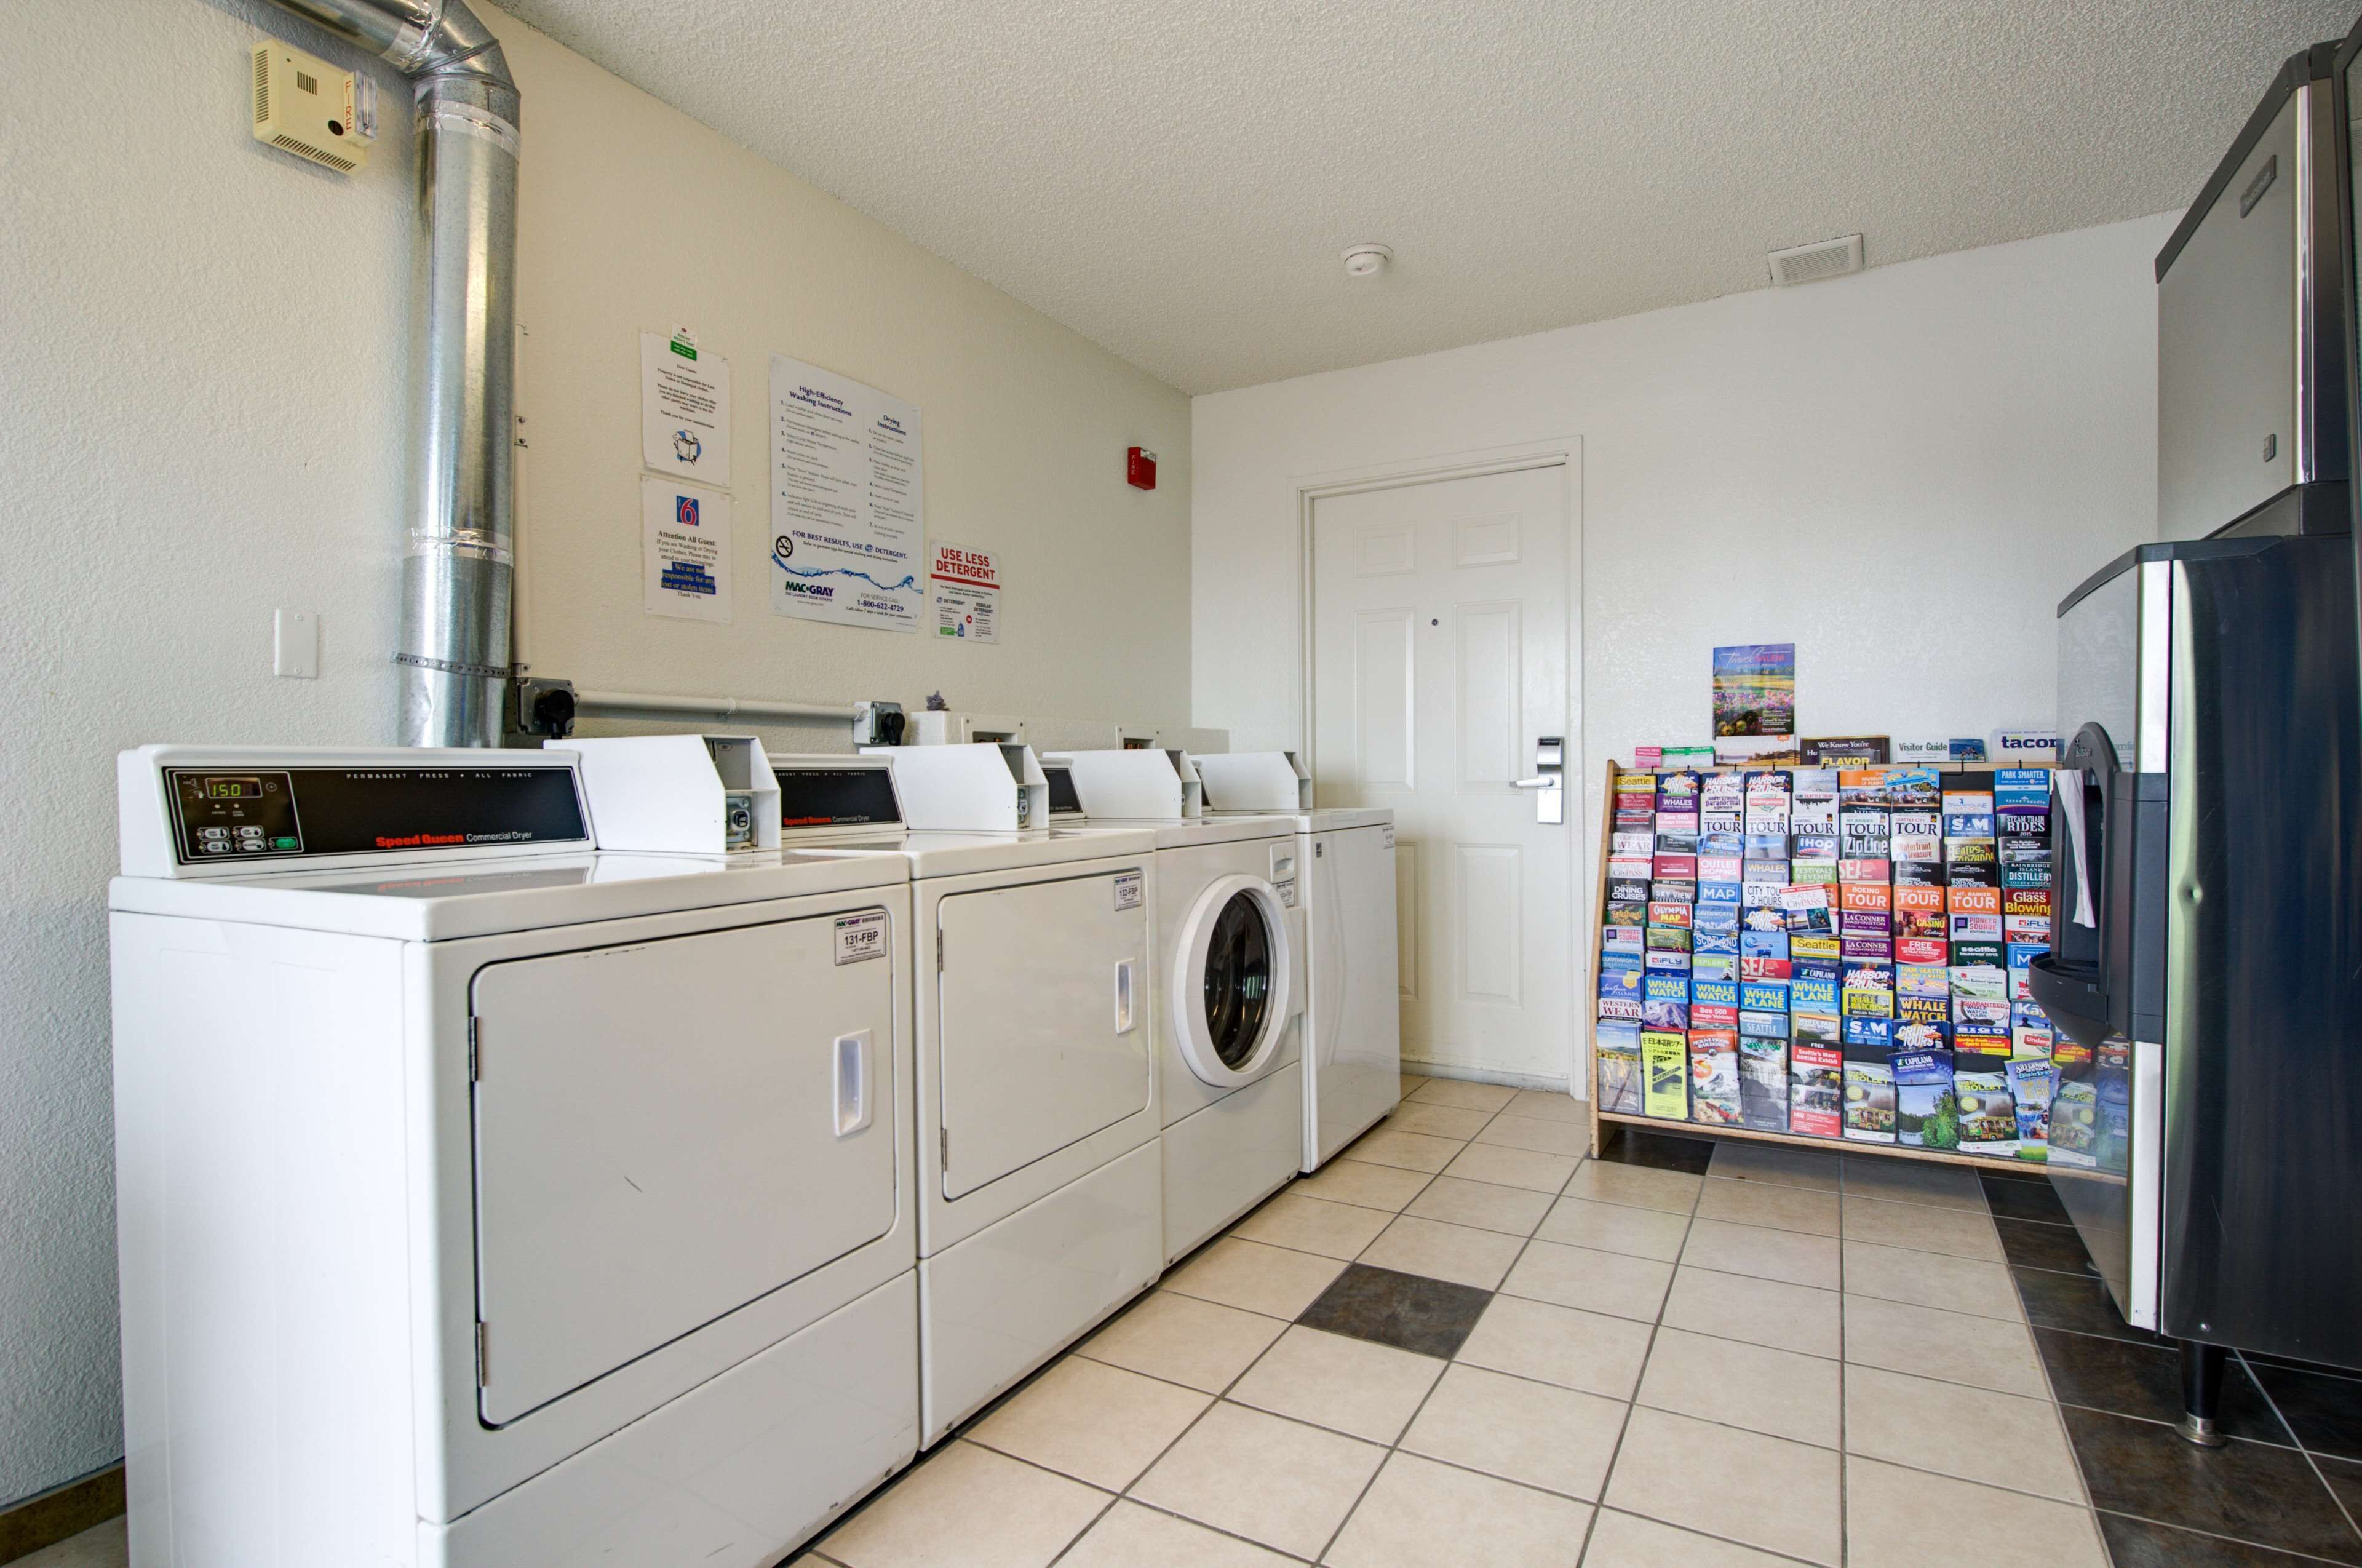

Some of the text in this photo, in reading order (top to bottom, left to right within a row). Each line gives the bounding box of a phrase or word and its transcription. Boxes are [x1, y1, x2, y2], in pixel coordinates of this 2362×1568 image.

[800, 386, 844, 405] High-Efficiency
[790, 391, 852, 416] Washing Instructions
[884, 415, 900, 427] Drying
[877, 421, 906, 436] Instructions
[680, 499, 696, 525] 6
[659, 531, 686, 541] Attention
[679, 542, 697, 552] Washing
[824, 537, 851, 547] RESULTS,
[875, 547, 908, 559] DETERGENT.
[941, 547, 989, 567] USE LESS
[936, 560, 995, 580] DETERGENT
[662, 573, 694, 582] responsible
[681, 583, 698, 591] stolen
[857, 600, 904, 612] 1-800-622-4729
[1899, 743, 1947, 752] Visitor Guide
[1664, 776, 1695, 785] CRUISE
[1748, 776, 1786, 784] HARBOR
[213, 784, 240, 797] 150
[784, 817, 808, 826] Speed
[808, 815, 832, 824] Queen
[1704, 822, 1741, 833] TOUR
[1748, 822, 1786, 834] TOUR
[1794, 823, 1835, 834] TOUR
[1846, 824, 1886, 835] TOUR
[1895, 823, 1937, 835] TOUR
[2007, 823, 2045, 832] RIDES
[376, 831, 532, 848] Speed Queen Commercial Dryer
[1800, 838, 1834, 850] IHOP
[1617, 841, 1650, 850] WEAR
[1846, 837, 1888, 855] ZipLine
[1748, 864, 1786, 873] WHALES
[2009, 872, 2052, 881] DISTILLERY
[1703, 888, 1736, 899] MAP
[1748, 886, 1764, 896] CITY
[1758, 897, 1782, 905] HOURS
[1787, 897, 1821, 907] CityPASS
[1847, 894, 1887, 907] TOUR
[1898, 893, 1939, 905] TOUR
[1952, 896, 1995, 909] TOUR
[2013, 892, 2046, 903] Glass
[1653, 905, 1688, 915] OLYMPIA
[2005, 903, 2051, 916] Blowing
[1749, 911, 1783, 920] CRUISE
[1751, 922, 1778, 931] TOURS
[1916, 918, 1945, 928] CASINO
[845, 931, 878, 945] 131-FBP
[1696, 936, 1737, 947] SCOTLAND
[1797, 939, 1835, 950] Seattle
[1810, 969, 1835, 979] CAPILANO
[1846, 969, 1888, 979] HARBOR
[1648, 979, 1685, 989] WHALE
[1696, 984, 1735, 993] WHALE
[1792, 983, 1834, 992] WHALE
[1845, 980, 1888, 990] CRUISE
[1648, 988, 1686, 998] WATCH
[1696, 993, 1736, 1001] WATCH
[1744, 990, 1784, 1000] WHALE
[1792, 992, 1834, 1001] PLANE
[1744, 998, 1784, 1008] PLANE
[1900, 1001, 1947, 1011] WHALE
[1603, 1008, 1639, 1017] WEAR
[1900, 1011, 1947, 1021] WATCH
[1747, 1023, 1776, 1033] SEATTLE
[1899, 1025, 1937, 1035] CRUISE
[1904, 1036, 1933, 1046] TOURS
[1905, 1056, 1933, 1066] CAPILANO
[1850, 1074, 1888, 1084] TROLLEY
